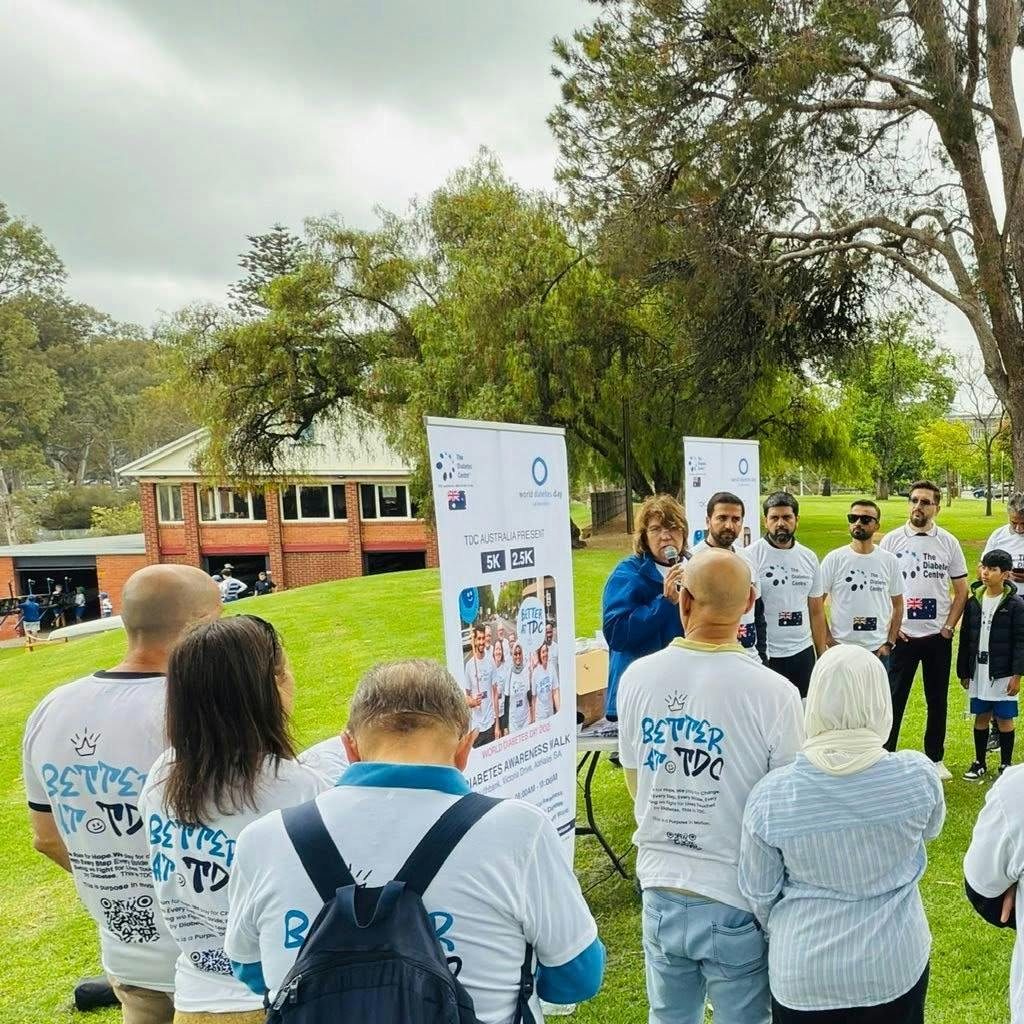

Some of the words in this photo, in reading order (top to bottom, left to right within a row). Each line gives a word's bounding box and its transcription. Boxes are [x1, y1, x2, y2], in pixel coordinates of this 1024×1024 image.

[464, 534, 479, 545] TDC
[481, 532, 516, 544] AUSTRALIA
[517, 529, 544, 540] PRESENT
[486, 553, 500, 570] 5K
[512, 550, 534, 566] 2.5K
[520, 607, 542, 620] BETTER
[527, 620, 544, 635] TDC
[642, 714, 724, 754] BETTER
[469, 764, 503, 788] IABETES
[504, 742, 548, 772] AWARENESS
[644, 748, 668, 771] AT
[674, 747, 724, 780] TDC
[96, 800, 144, 836] TD
[152, 852, 176, 882] AT
[182, 856, 230, 894] TD
